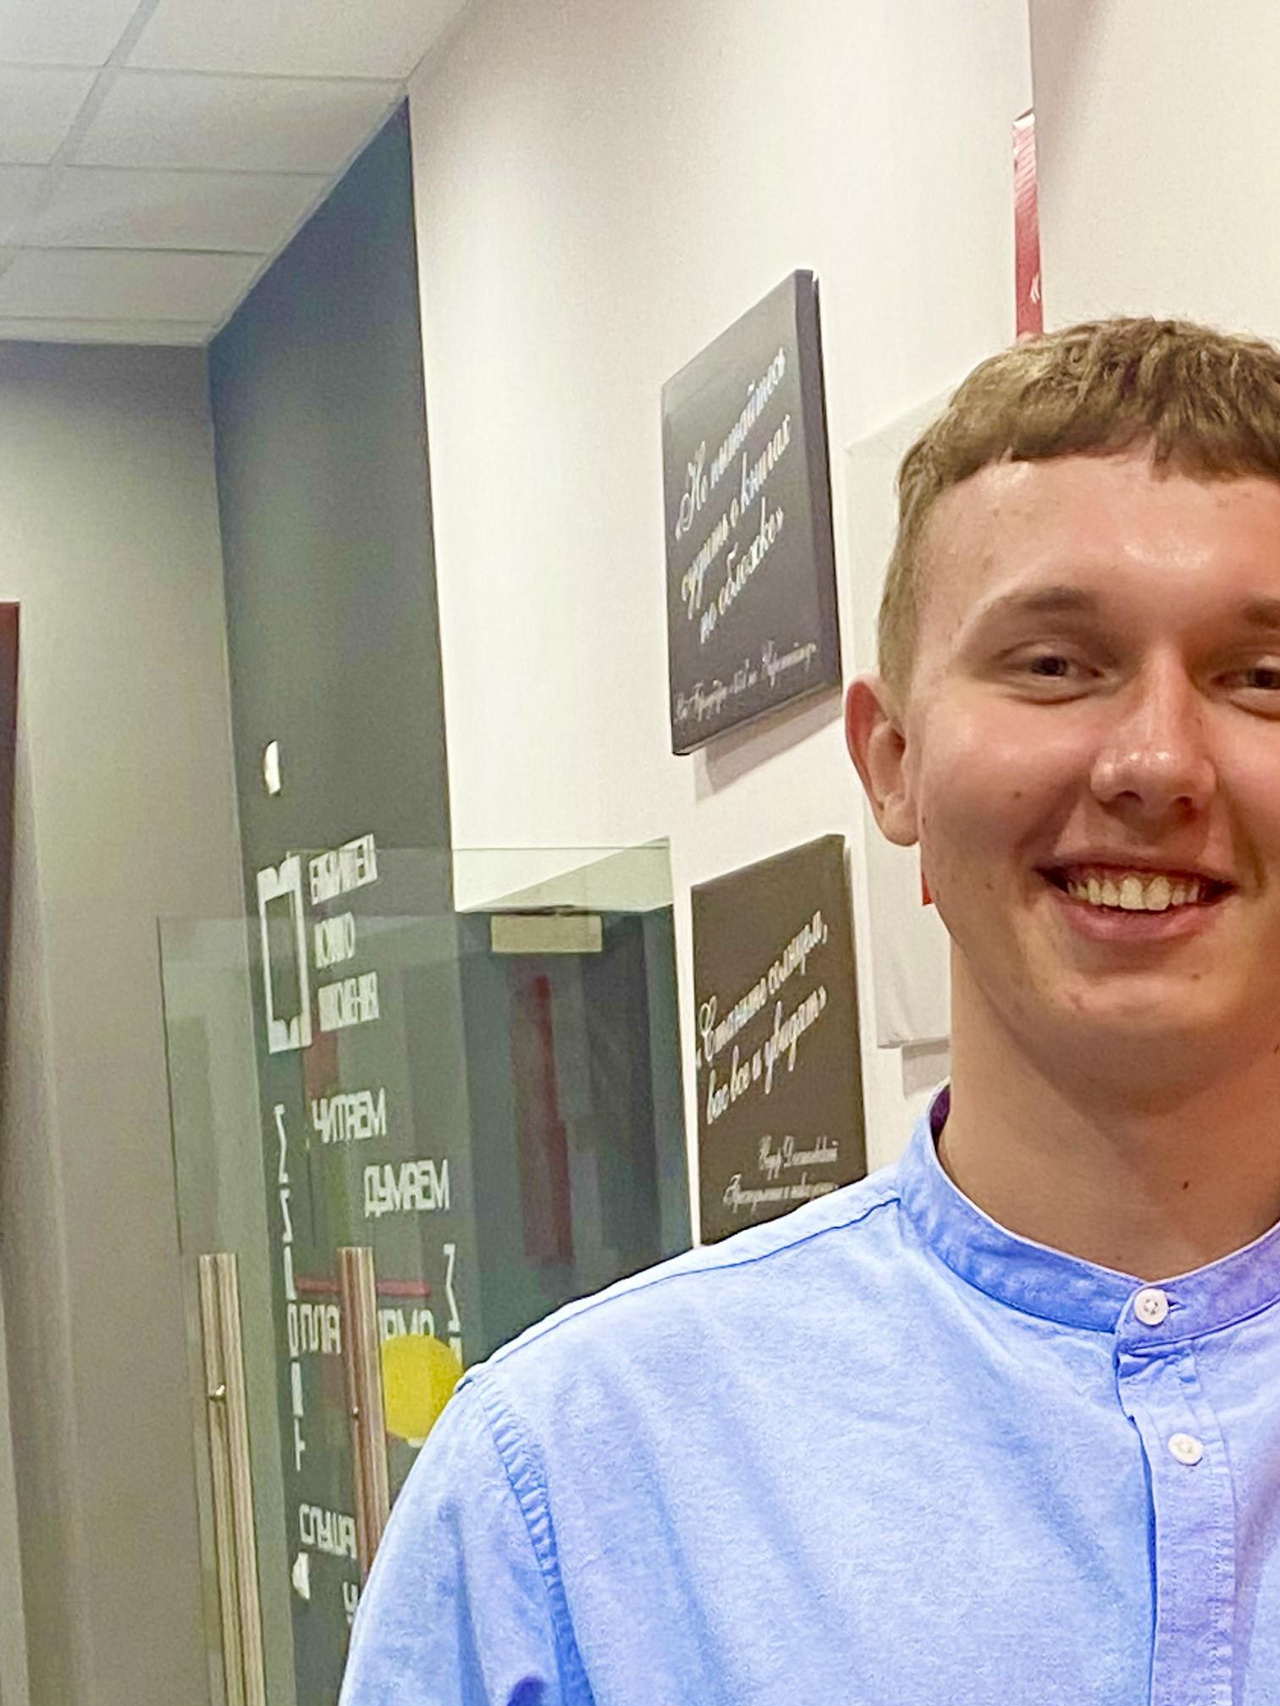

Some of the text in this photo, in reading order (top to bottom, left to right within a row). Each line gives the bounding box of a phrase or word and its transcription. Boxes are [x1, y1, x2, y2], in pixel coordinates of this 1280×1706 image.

[311, 1087, 387, 1144] ЧИТАЕМ
[363, 1158, 450, 1218] ДУМАЕМ
[299, 1503, 358, 1559] СЛУША
